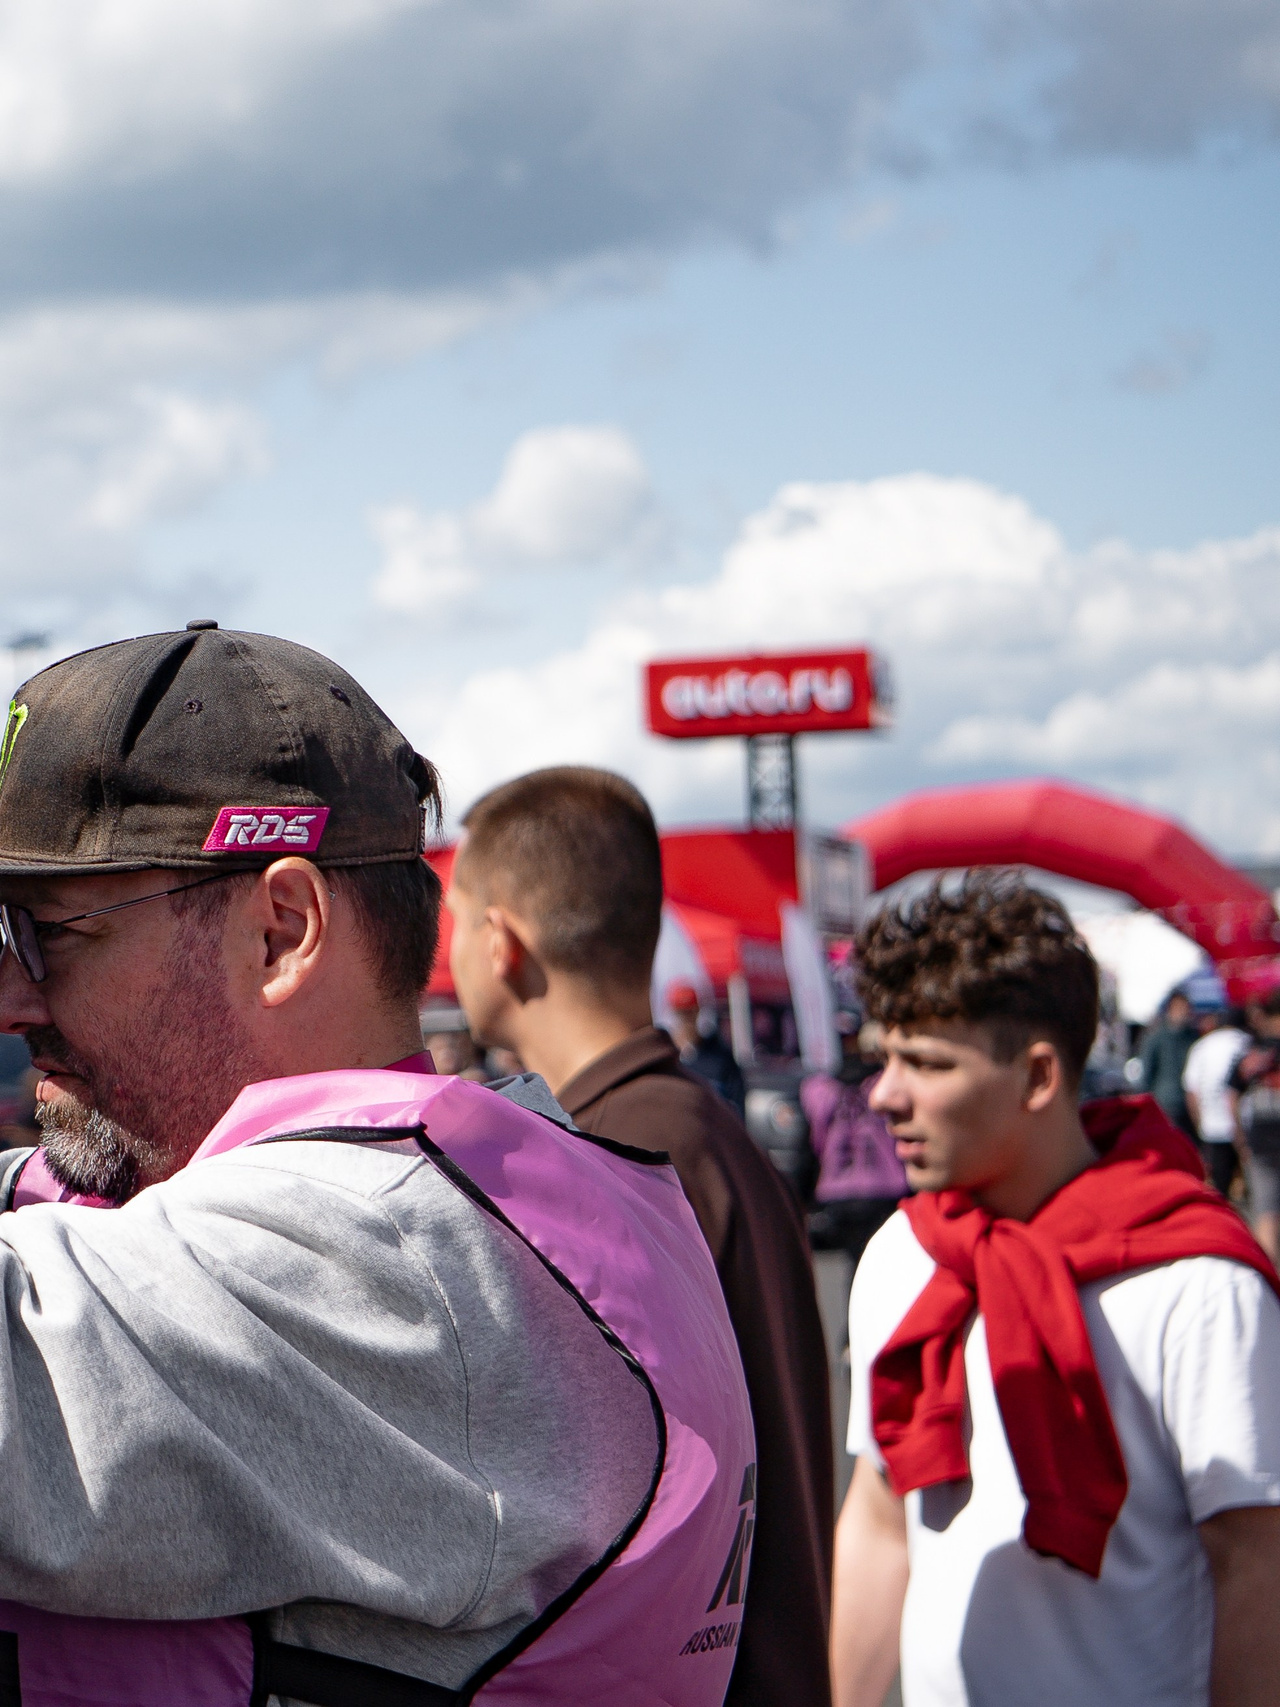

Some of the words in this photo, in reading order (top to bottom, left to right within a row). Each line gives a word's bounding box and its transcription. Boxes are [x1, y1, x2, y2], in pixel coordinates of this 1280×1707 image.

[661, 667, 853, 721] auto.ru
[224, 815, 317, 845] RDS
[679, 1622, 739, 1656] RUSSIAN
